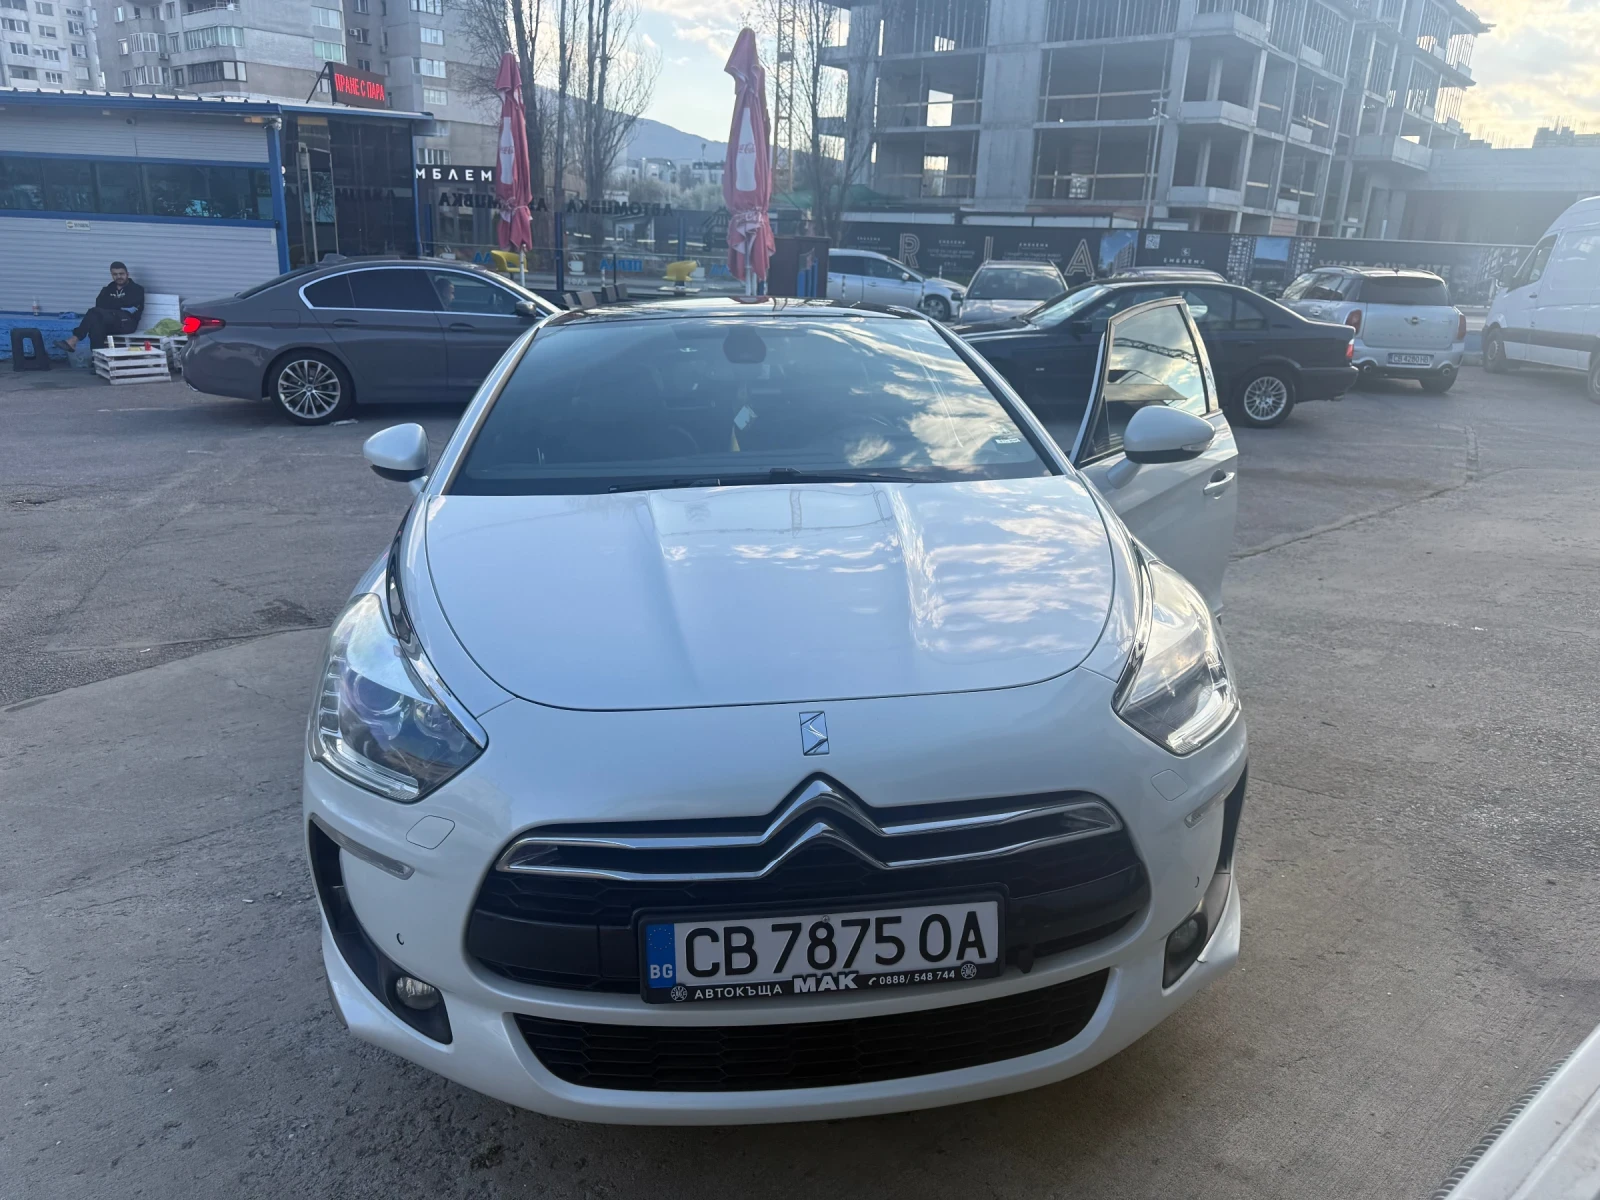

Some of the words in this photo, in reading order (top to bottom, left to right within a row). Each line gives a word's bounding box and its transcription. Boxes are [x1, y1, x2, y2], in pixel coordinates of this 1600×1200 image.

[334, 73, 360, 97] ПРАНЕ
[360, 79, 366, 98] С
[366, 81, 385, 101] ПАРА
[685, 926, 758, 978] CB
[771, 912, 906, 974] 7875
[918, 911, 987, 963] OA
[650, 963, 673, 979] BG
[694, 984, 783, 1000] АВТОКЪЩА
[793, 973, 859, 993] МАК
[879, 974, 911, 985] 0888/
[914, 972, 933, 982] 548
[936, 970, 955, 980] 744
